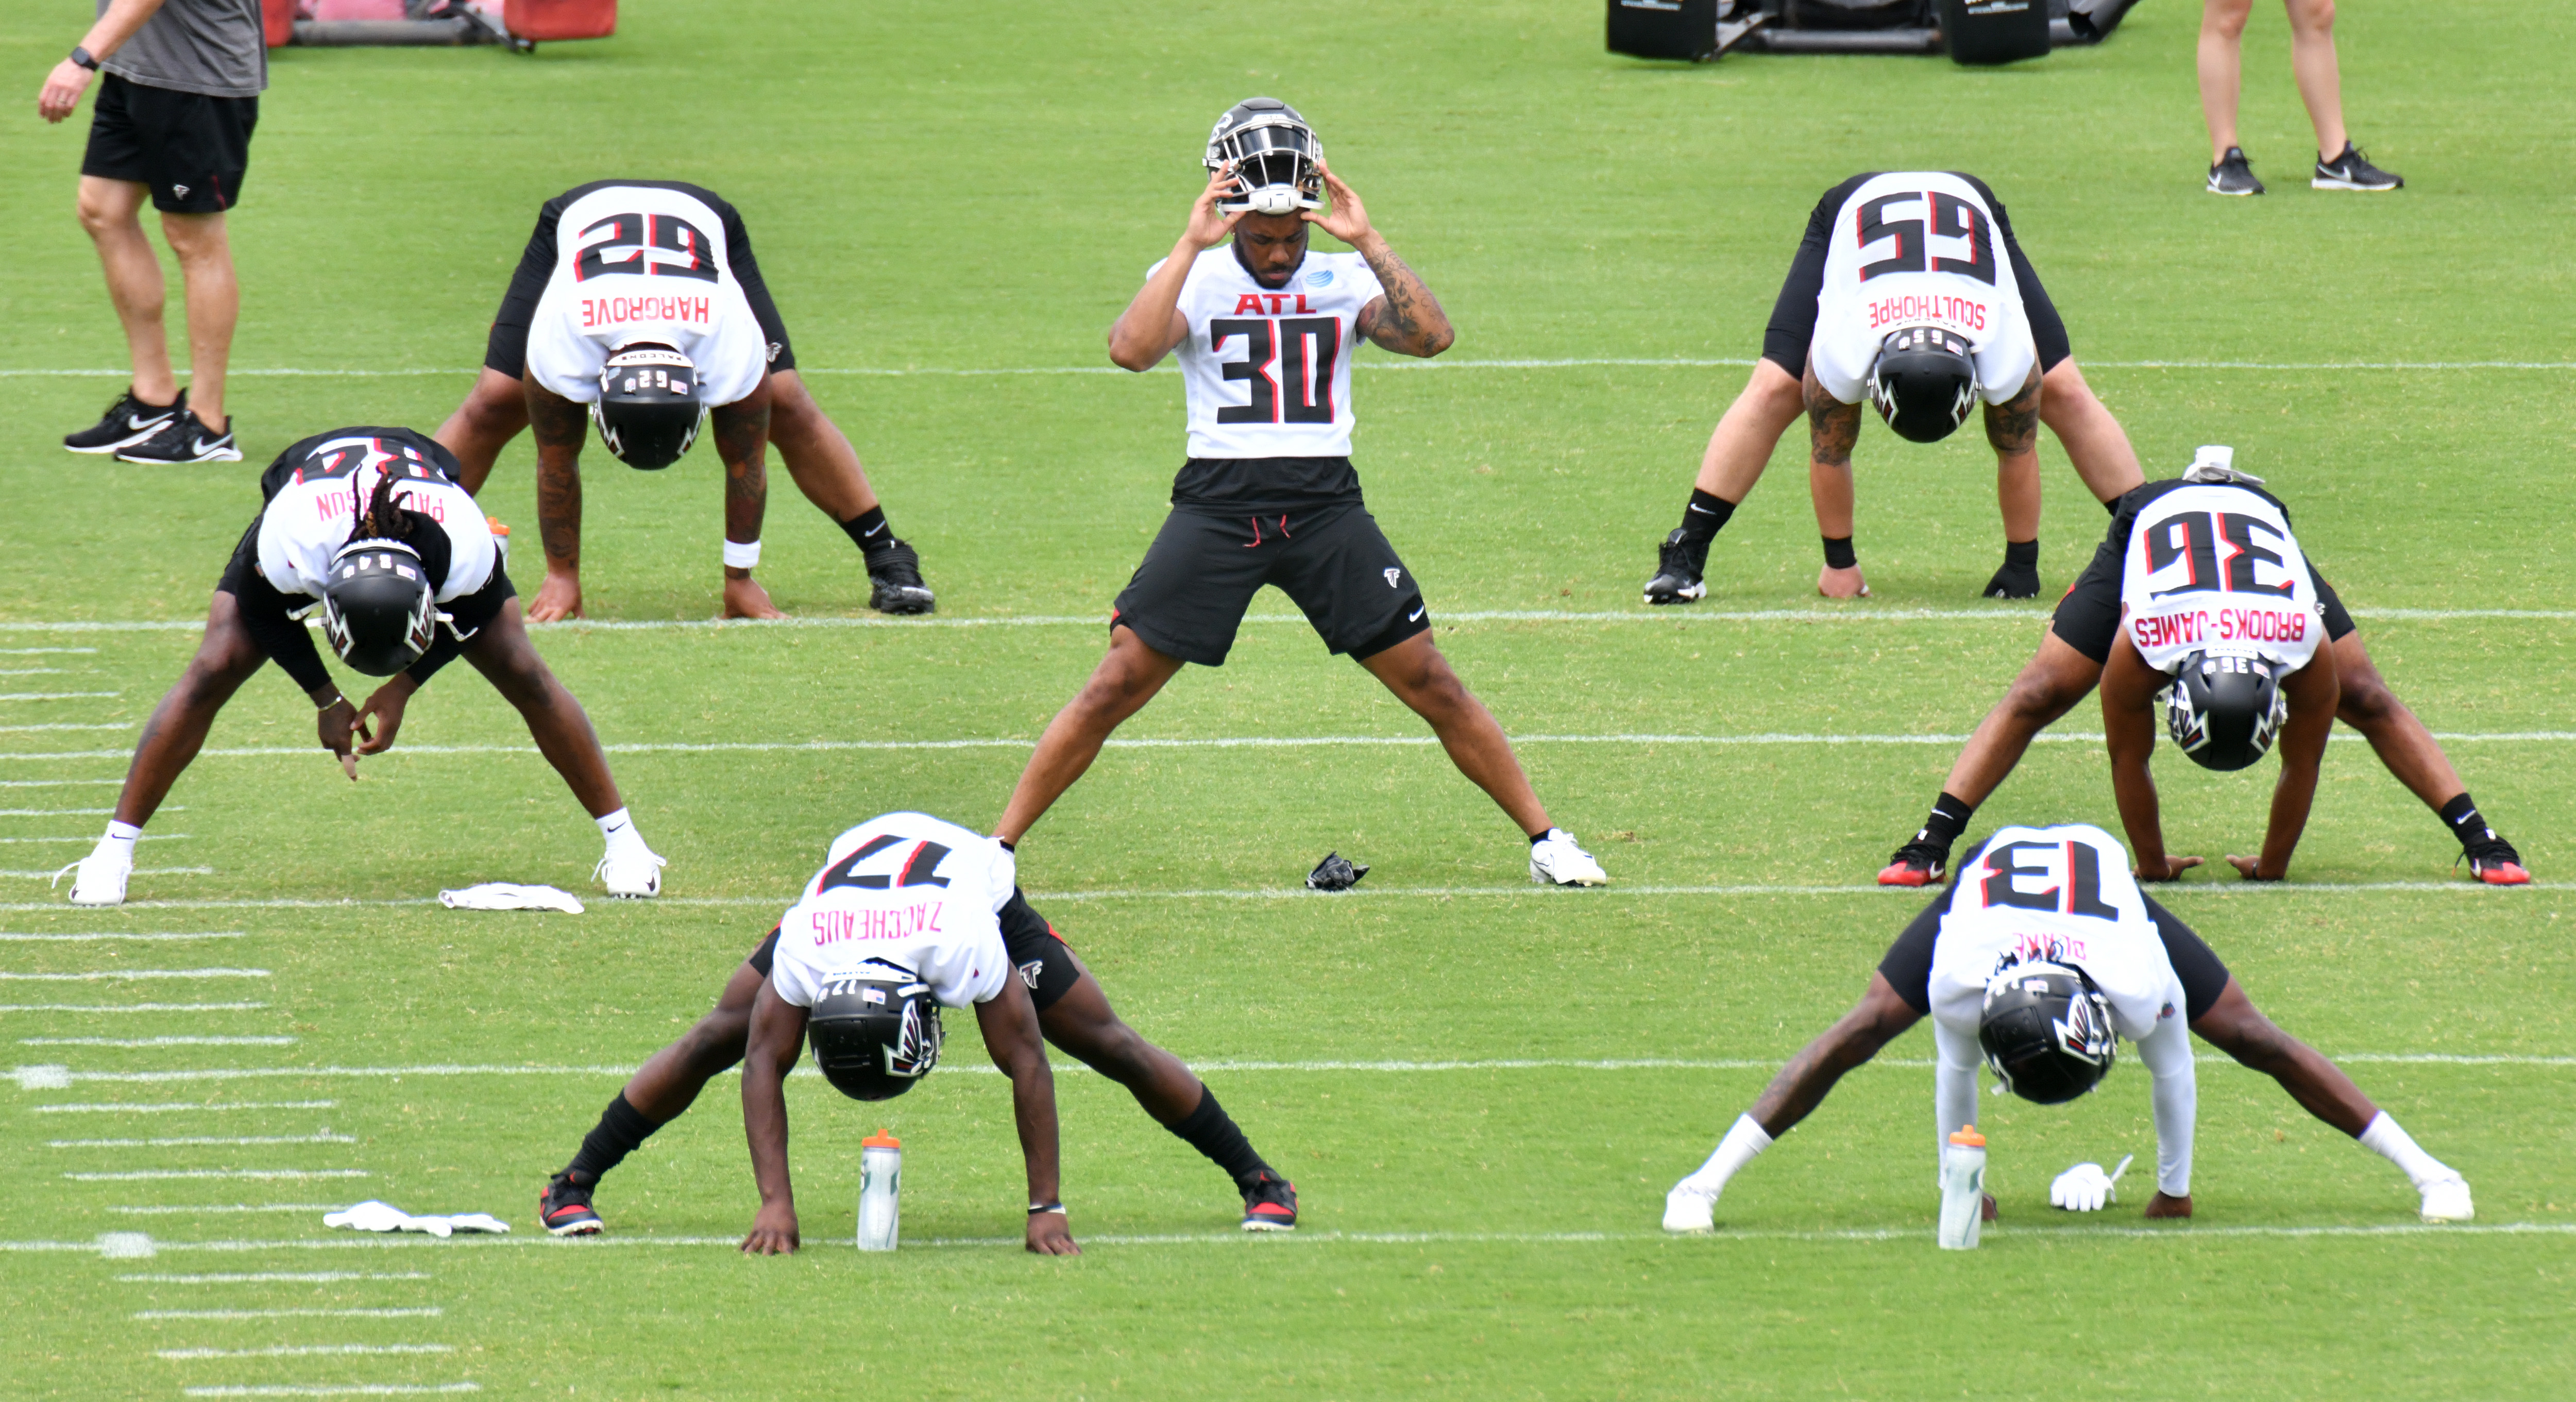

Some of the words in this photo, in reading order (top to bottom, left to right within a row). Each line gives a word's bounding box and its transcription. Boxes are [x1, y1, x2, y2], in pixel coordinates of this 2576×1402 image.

[574, 213, 718, 283] 62
[1856, 191, 1996, 286] 65
[583, 297, 708, 327] HARGROVE
[1234, 294, 1316, 315] ATL
[1869, 296, 1986, 330] SCULTHORPE
[1913, 330, 1942, 344] 65
[622, 353, 682, 361] FALCONS
[1210, 317, 1341, 424] 30
[638, 370, 668, 388] 62
[295, 437, 453, 488] 84
[316, 487, 444, 523] PARSON
[359, 553, 392, 570] 84
[2144, 511, 2295, 601] 36
[2136, 609, 2305, 647] BROOKS-JAMES
[2221, 656, 2248, 674] 36
[817, 834, 953, 897] 17
[1980, 840, 2119, 922] 13
[813, 901, 943, 946] ZACCHEAUS
[832, 979, 857, 995] 17
